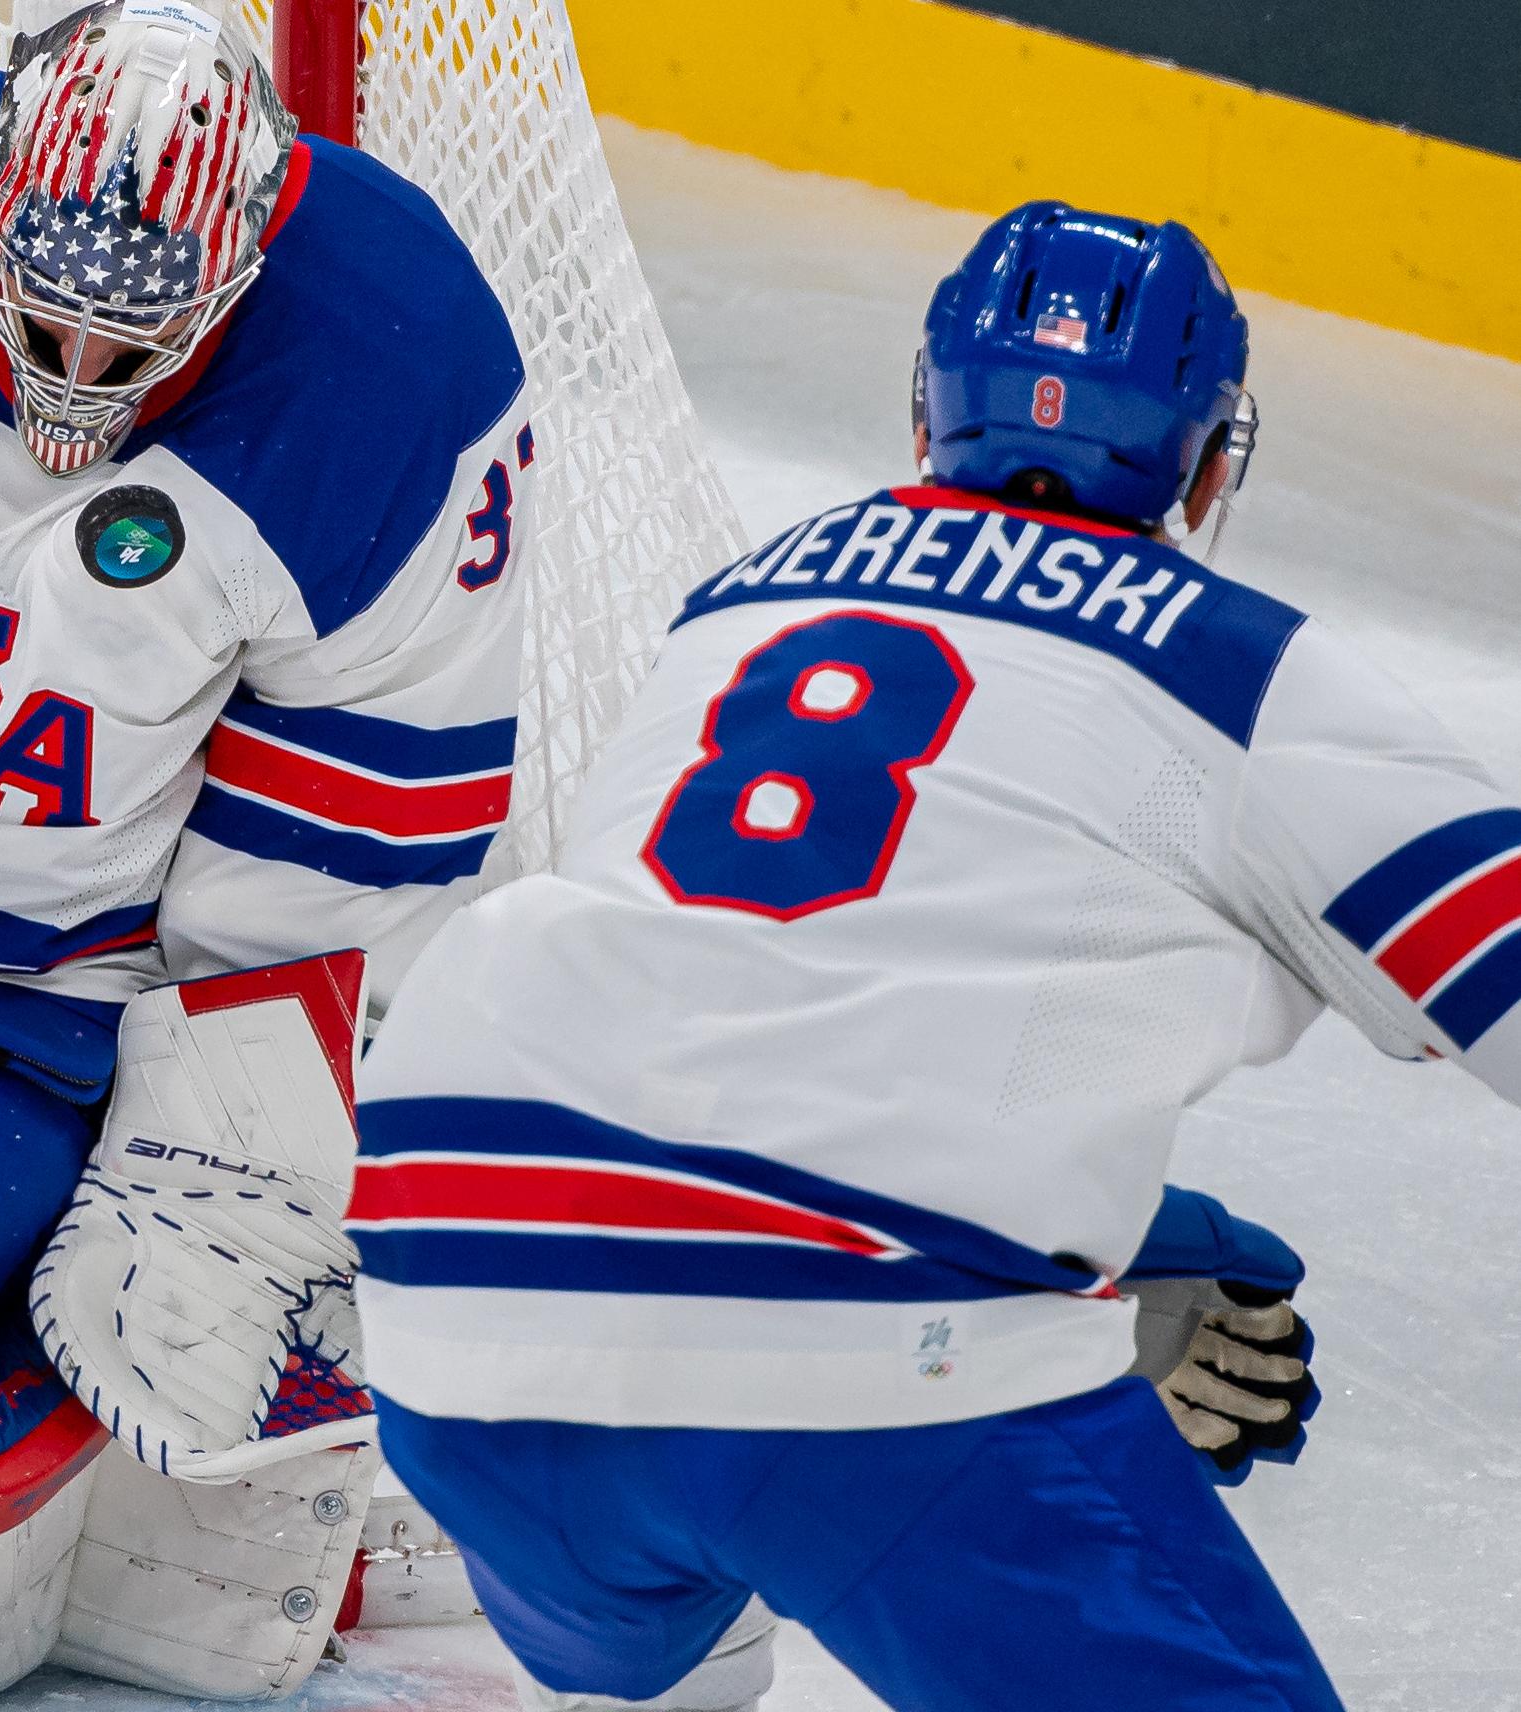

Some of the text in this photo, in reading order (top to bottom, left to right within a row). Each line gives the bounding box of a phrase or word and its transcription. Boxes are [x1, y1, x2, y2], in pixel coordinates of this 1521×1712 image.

[129, 9, 212, 32] MILANO CORTINA
[1031, 375, 1065, 429] 8
[36, 417, 86, 442] USA
[708, 503, 1204, 649] WERENSKI
[637, 608, 976, 924] 8
[124, 1136, 293, 1186] TRUE
